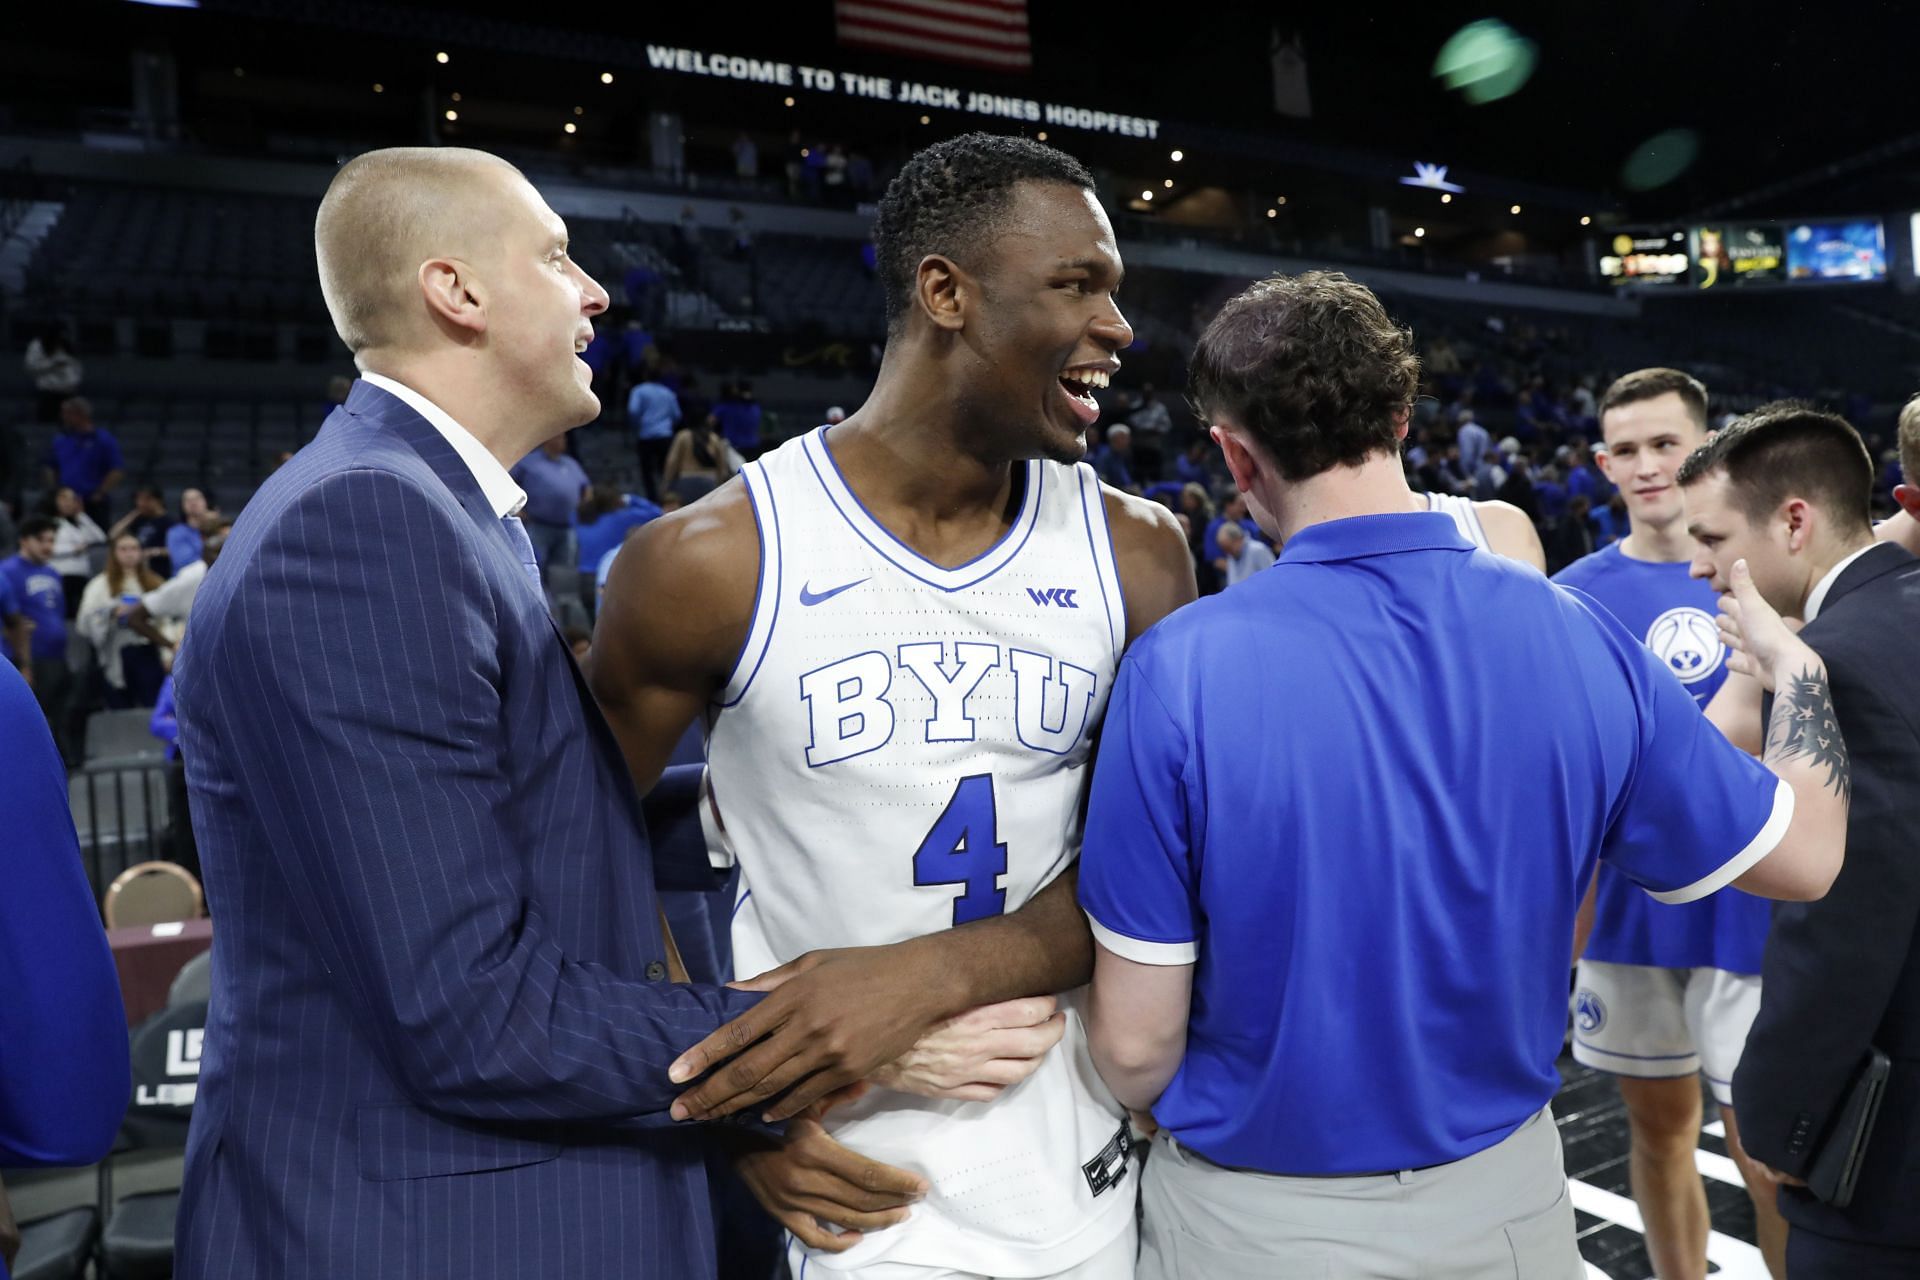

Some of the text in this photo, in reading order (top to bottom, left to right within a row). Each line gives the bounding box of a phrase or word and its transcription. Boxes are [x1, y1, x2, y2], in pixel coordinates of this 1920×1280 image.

[647, 44, 1160, 140] WELCOME TO THE JACK JONES HOOPFEST
[1026, 587, 1080, 609] WCC
[800, 641, 1097, 769] BYU
[912, 772, 1008, 927] 4
